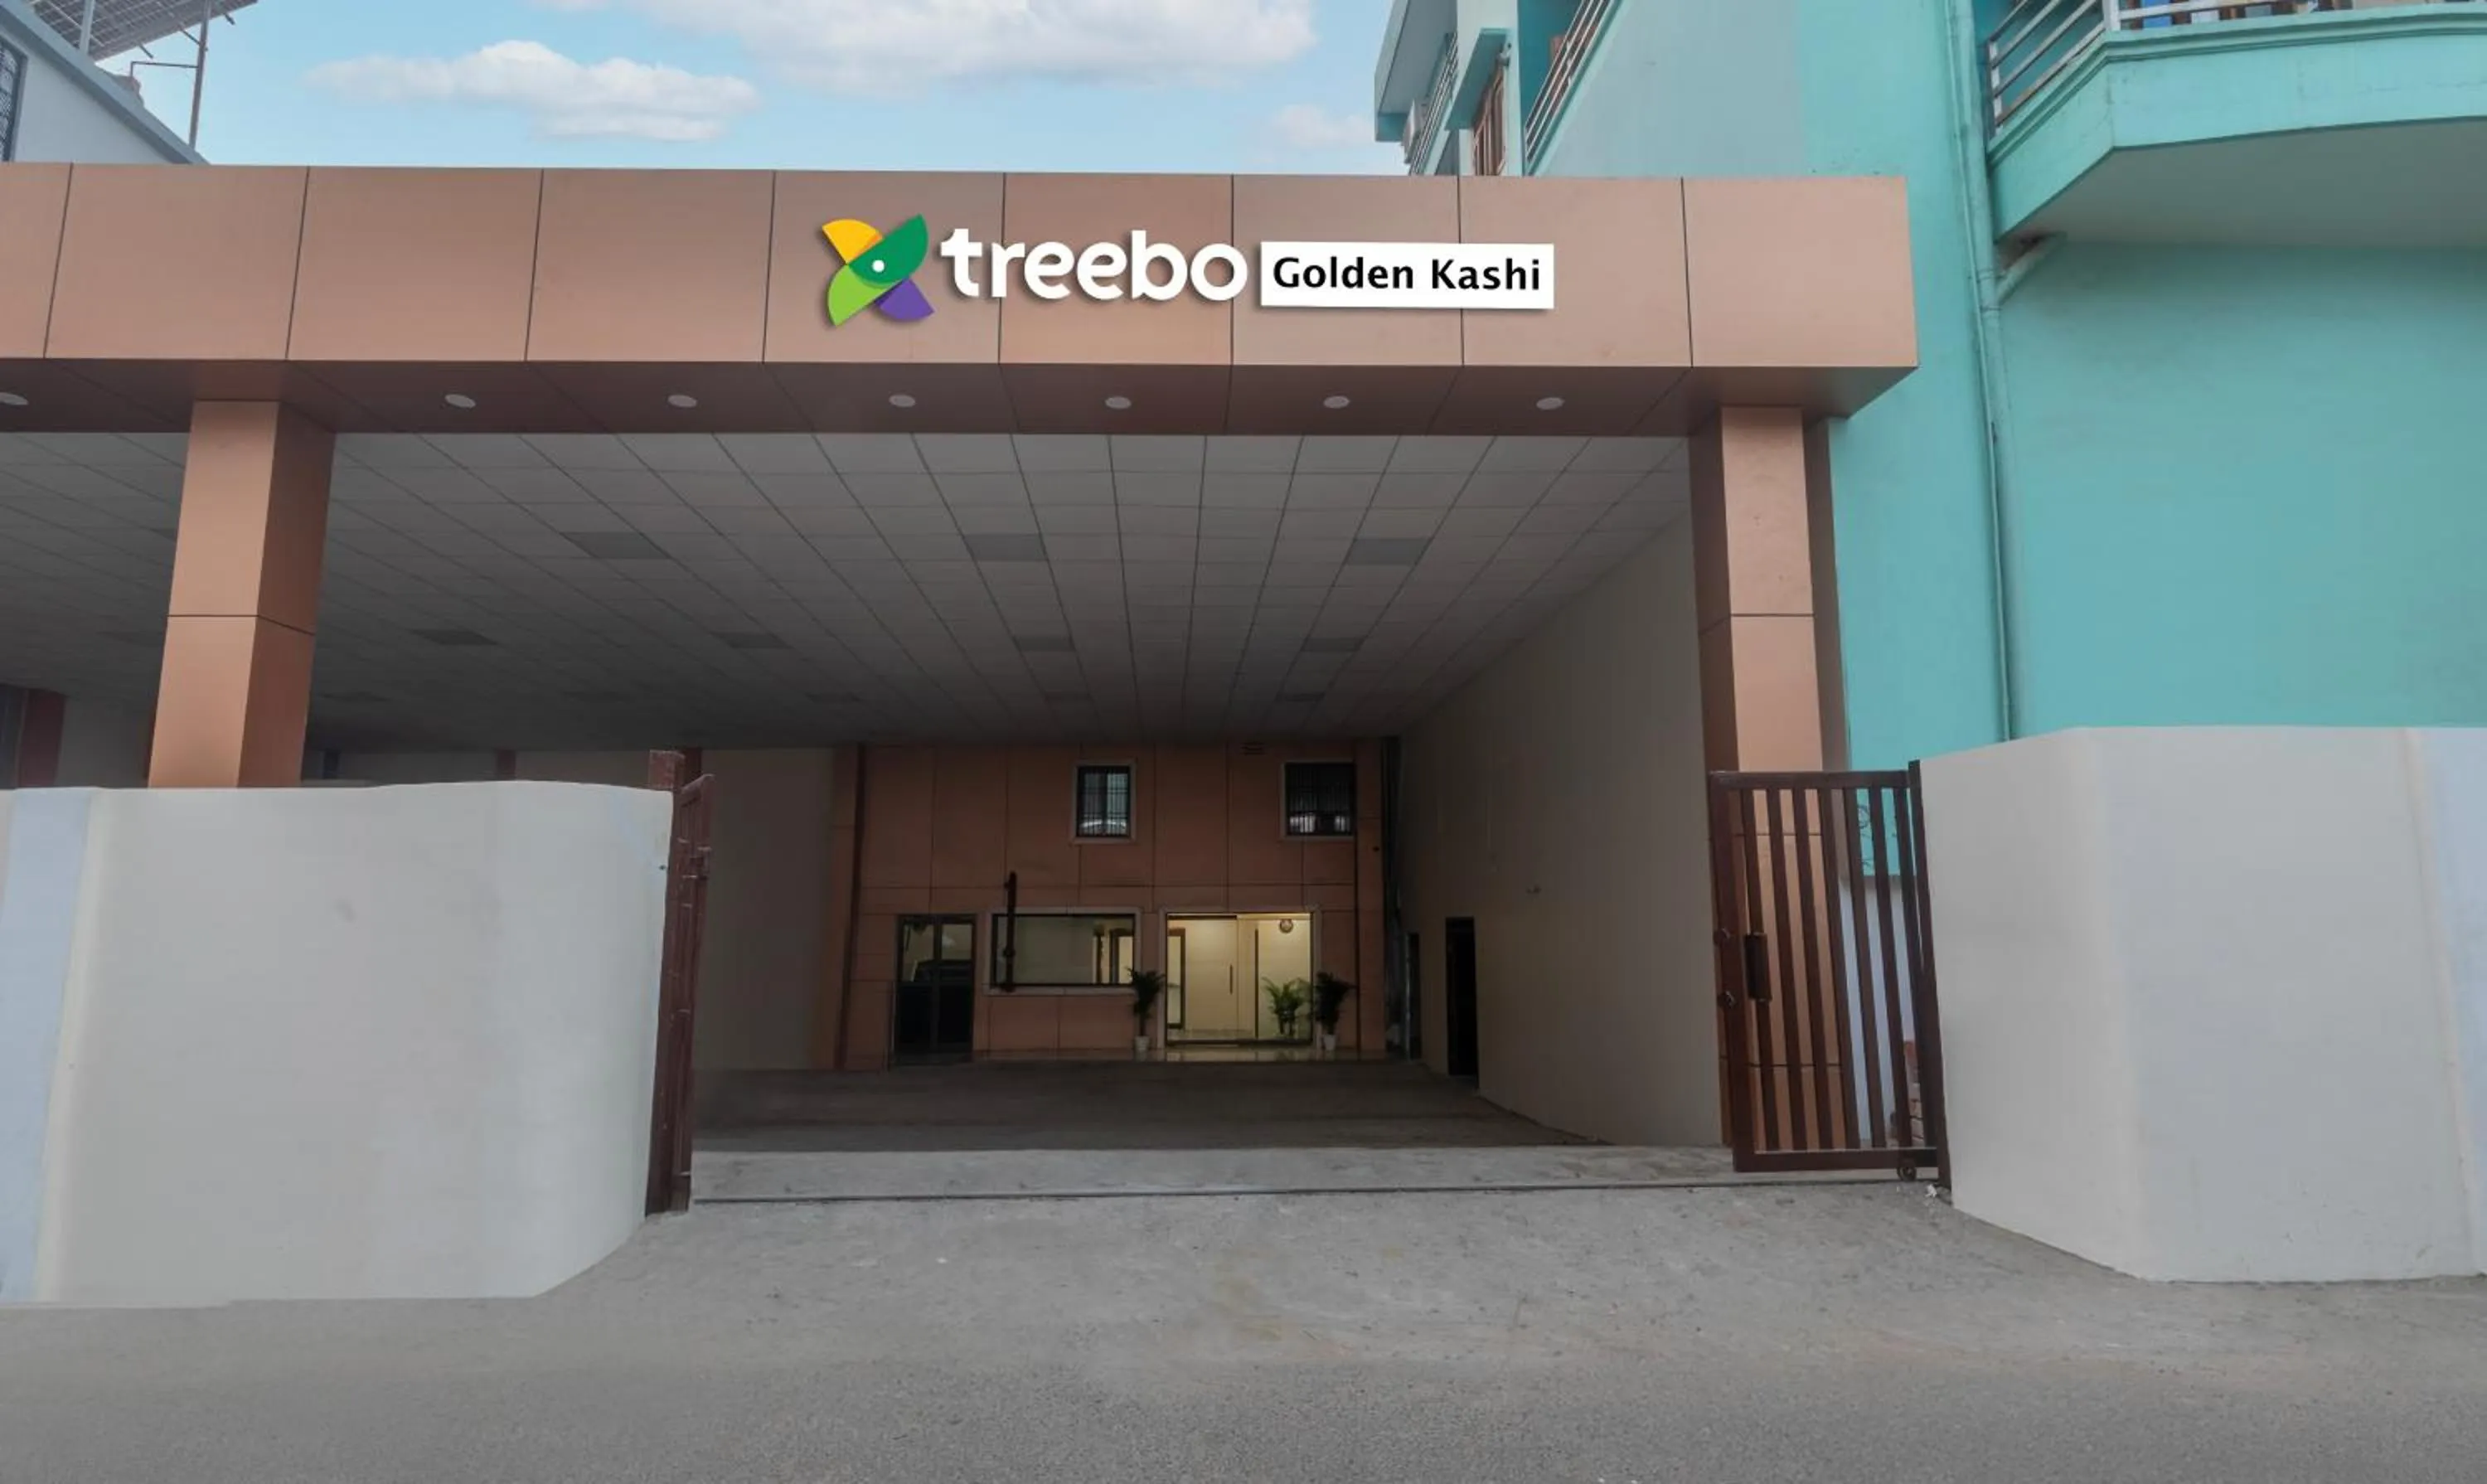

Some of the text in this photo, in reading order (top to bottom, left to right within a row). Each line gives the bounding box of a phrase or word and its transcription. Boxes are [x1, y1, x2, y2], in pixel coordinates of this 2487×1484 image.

[940, 227, 1540, 301] treebo Golden Kashi
